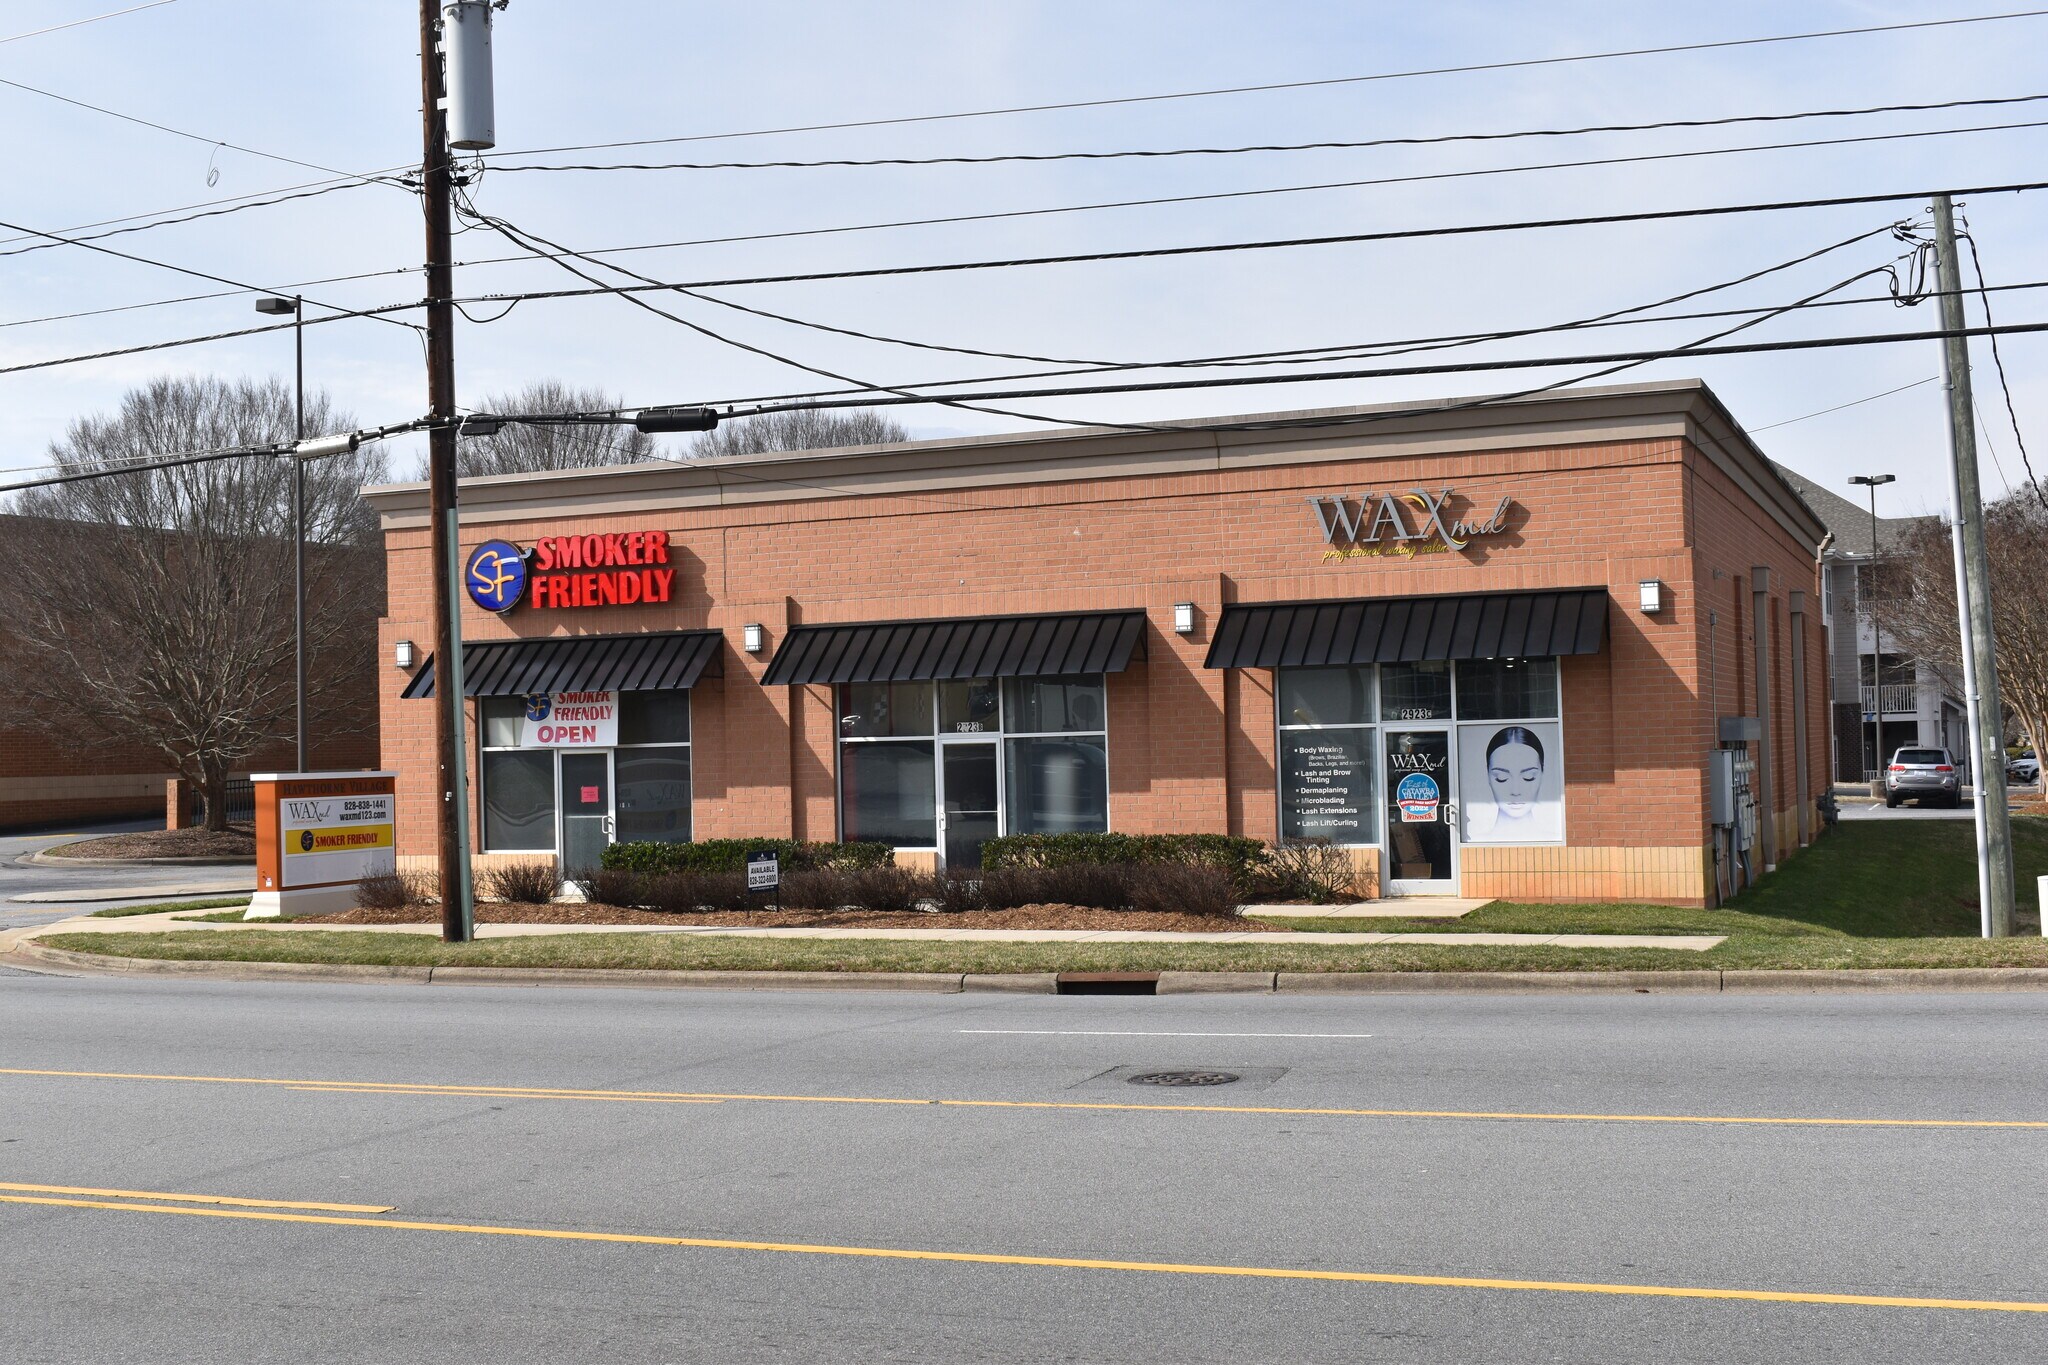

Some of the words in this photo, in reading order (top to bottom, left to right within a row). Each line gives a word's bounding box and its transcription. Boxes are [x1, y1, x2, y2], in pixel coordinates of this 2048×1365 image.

[535, 530, 670, 571] SMOKER
[1321, 542, 1383, 564] professional
[1386, 544, 1417, 560] waxing
[1421, 538, 1449, 555] salon
[471, 550, 519, 602] SF
[531, 568, 678, 609] FRIENDLY
[554, 705, 614, 721] FRIENDLY
[537, 725, 597, 743] OPEN
[1299, 747, 1317, 755] Body
[1318, 746, 1343, 754] Waxing
[283, 782, 346, 795] HAWTHORNE
[349, 780, 388, 792] VILLAGE
[344, 799, 386, 811] 828-838-1441
[1301, 797, 1345, 805] Microblading
[339, 810, 387, 822] waxmd123.com
[1320, 819, 1358, 827] Lift/Curling
[1406, 812, 1433, 820] WINNER
[315, 835, 346, 848] SMOKER
[346, 832, 379, 845] FRIENDLY
[751, 866, 775, 874] AVAILABLE
